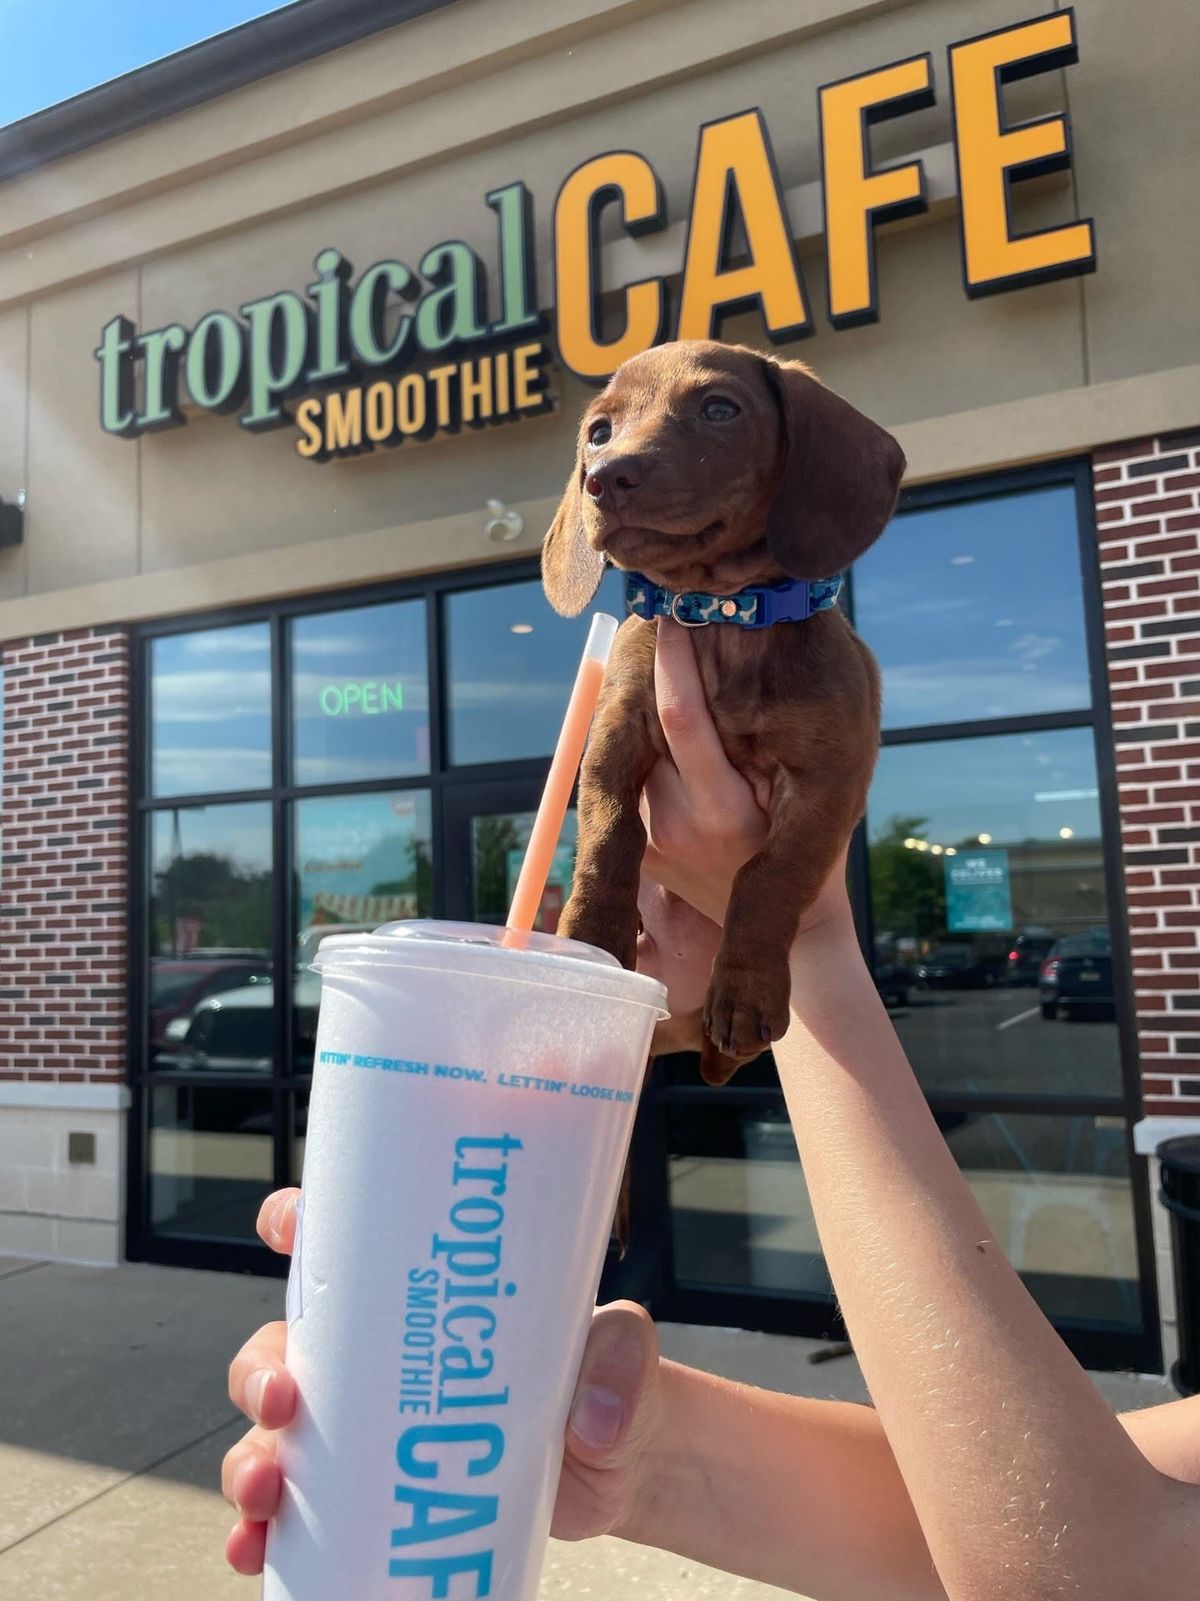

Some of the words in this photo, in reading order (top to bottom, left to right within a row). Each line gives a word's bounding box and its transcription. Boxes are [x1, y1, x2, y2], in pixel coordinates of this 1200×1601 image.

[95, 181, 546, 436] tropical
[553, 7, 1096, 382] CAFE
[295, 342, 547, 459] SMOOTHIE
[319, 680, 404, 717] OPEN
[353, 1055, 429, 1076] REFRESH
[434, 1063, 488, 1083] NOW.
[497, 1072, 568, 1094] LETTIN'
[571, 1083, 614, 1100] LOOSE
[431, 1133, 523, 1415] tropical
[400, 1268, 440, 1415] SMOOTHIE
